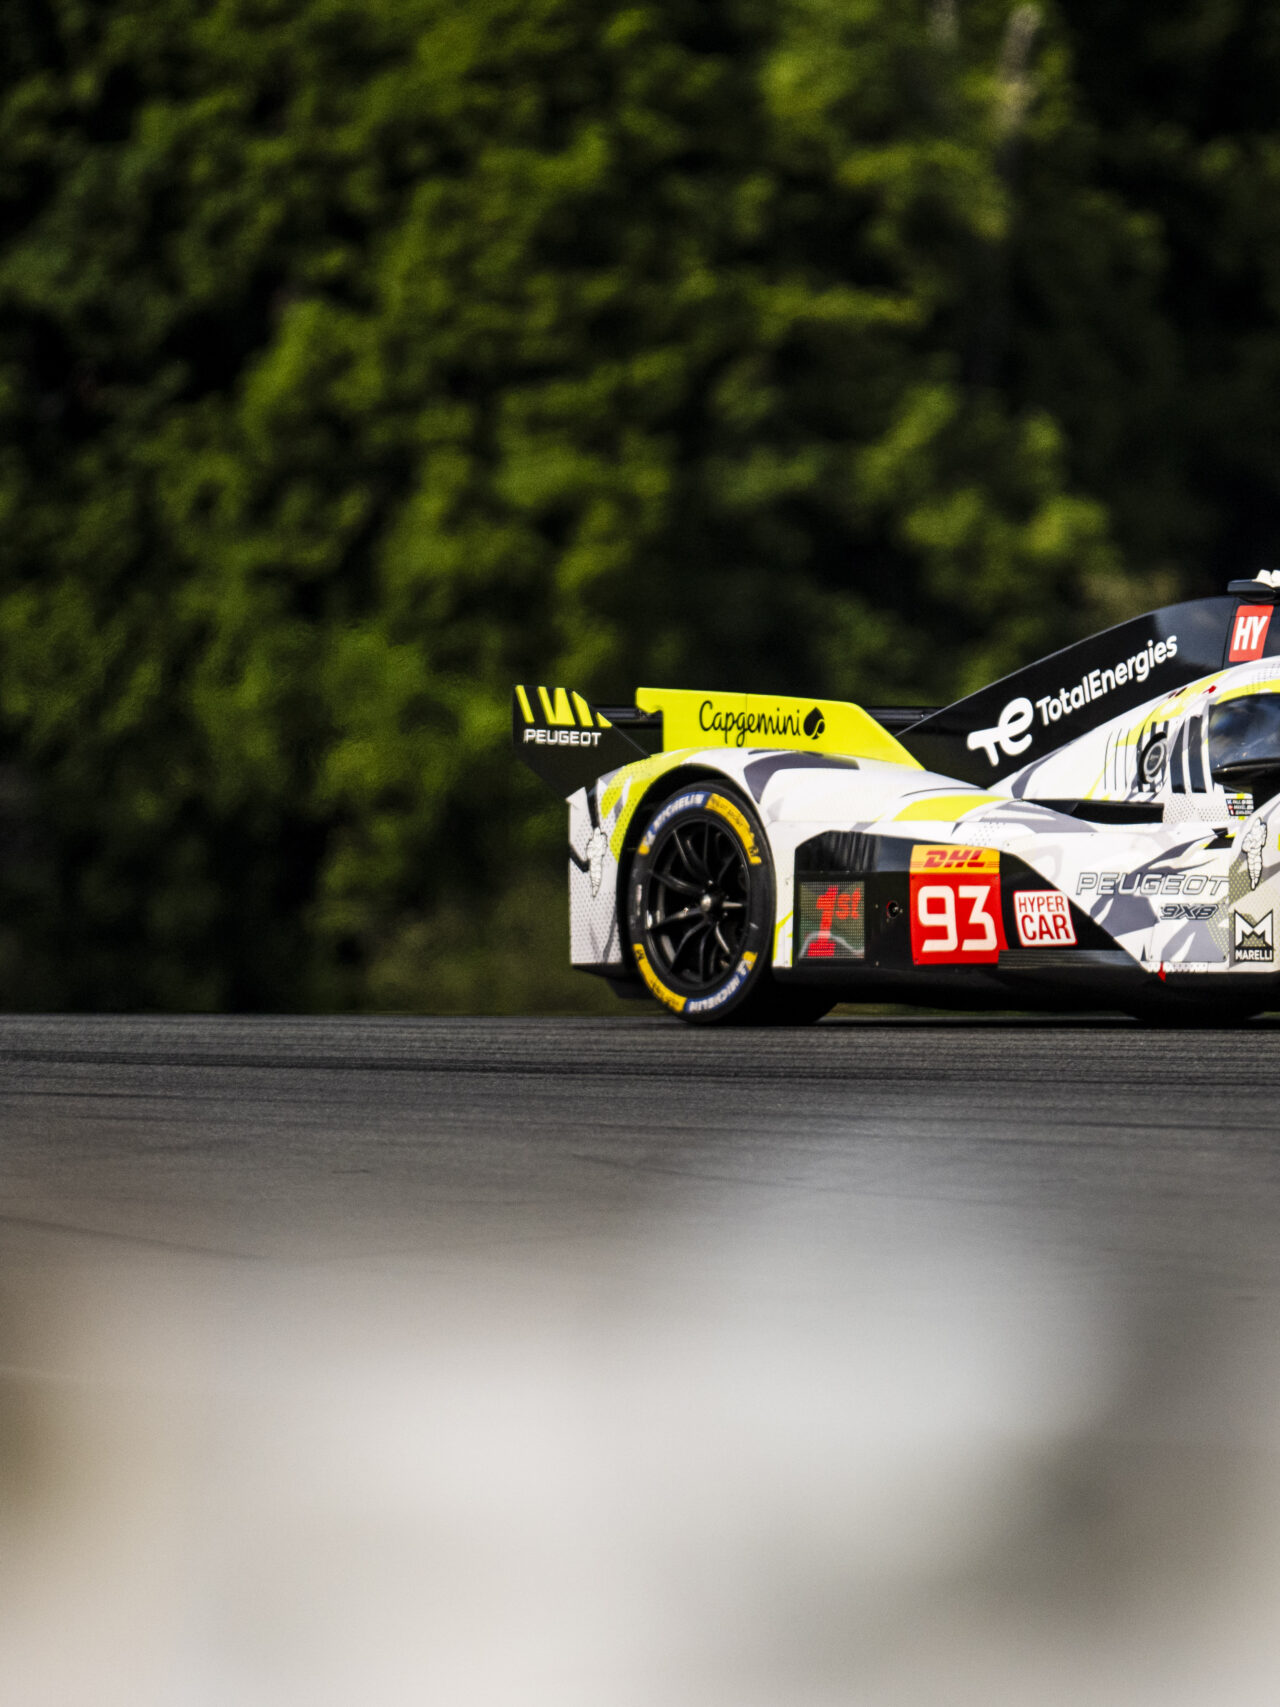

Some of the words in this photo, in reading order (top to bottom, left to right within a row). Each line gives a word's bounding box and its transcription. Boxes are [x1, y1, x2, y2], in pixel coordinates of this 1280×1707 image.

[1233, 615, 1269, 652] HY
[1035, 635, 1178, 727] TotalEnergies
[524, 728, 602, 747] PEUGEOT
[699, 700, 801, 748] Capgemini
[923, 849, 989, 869] DHL
[1075, 871, 1231, 897] PEUGEOT
[1018, 890, 1065, 912] HYPER
[1160, 902, 1219, 921] 9X8
[808, 884, 862, 958] 1st
[917, 884, 998, 953] 93
[1022, 912, 1072, 942] CAR
[1235, 949, 1273, 961] MARELLI
